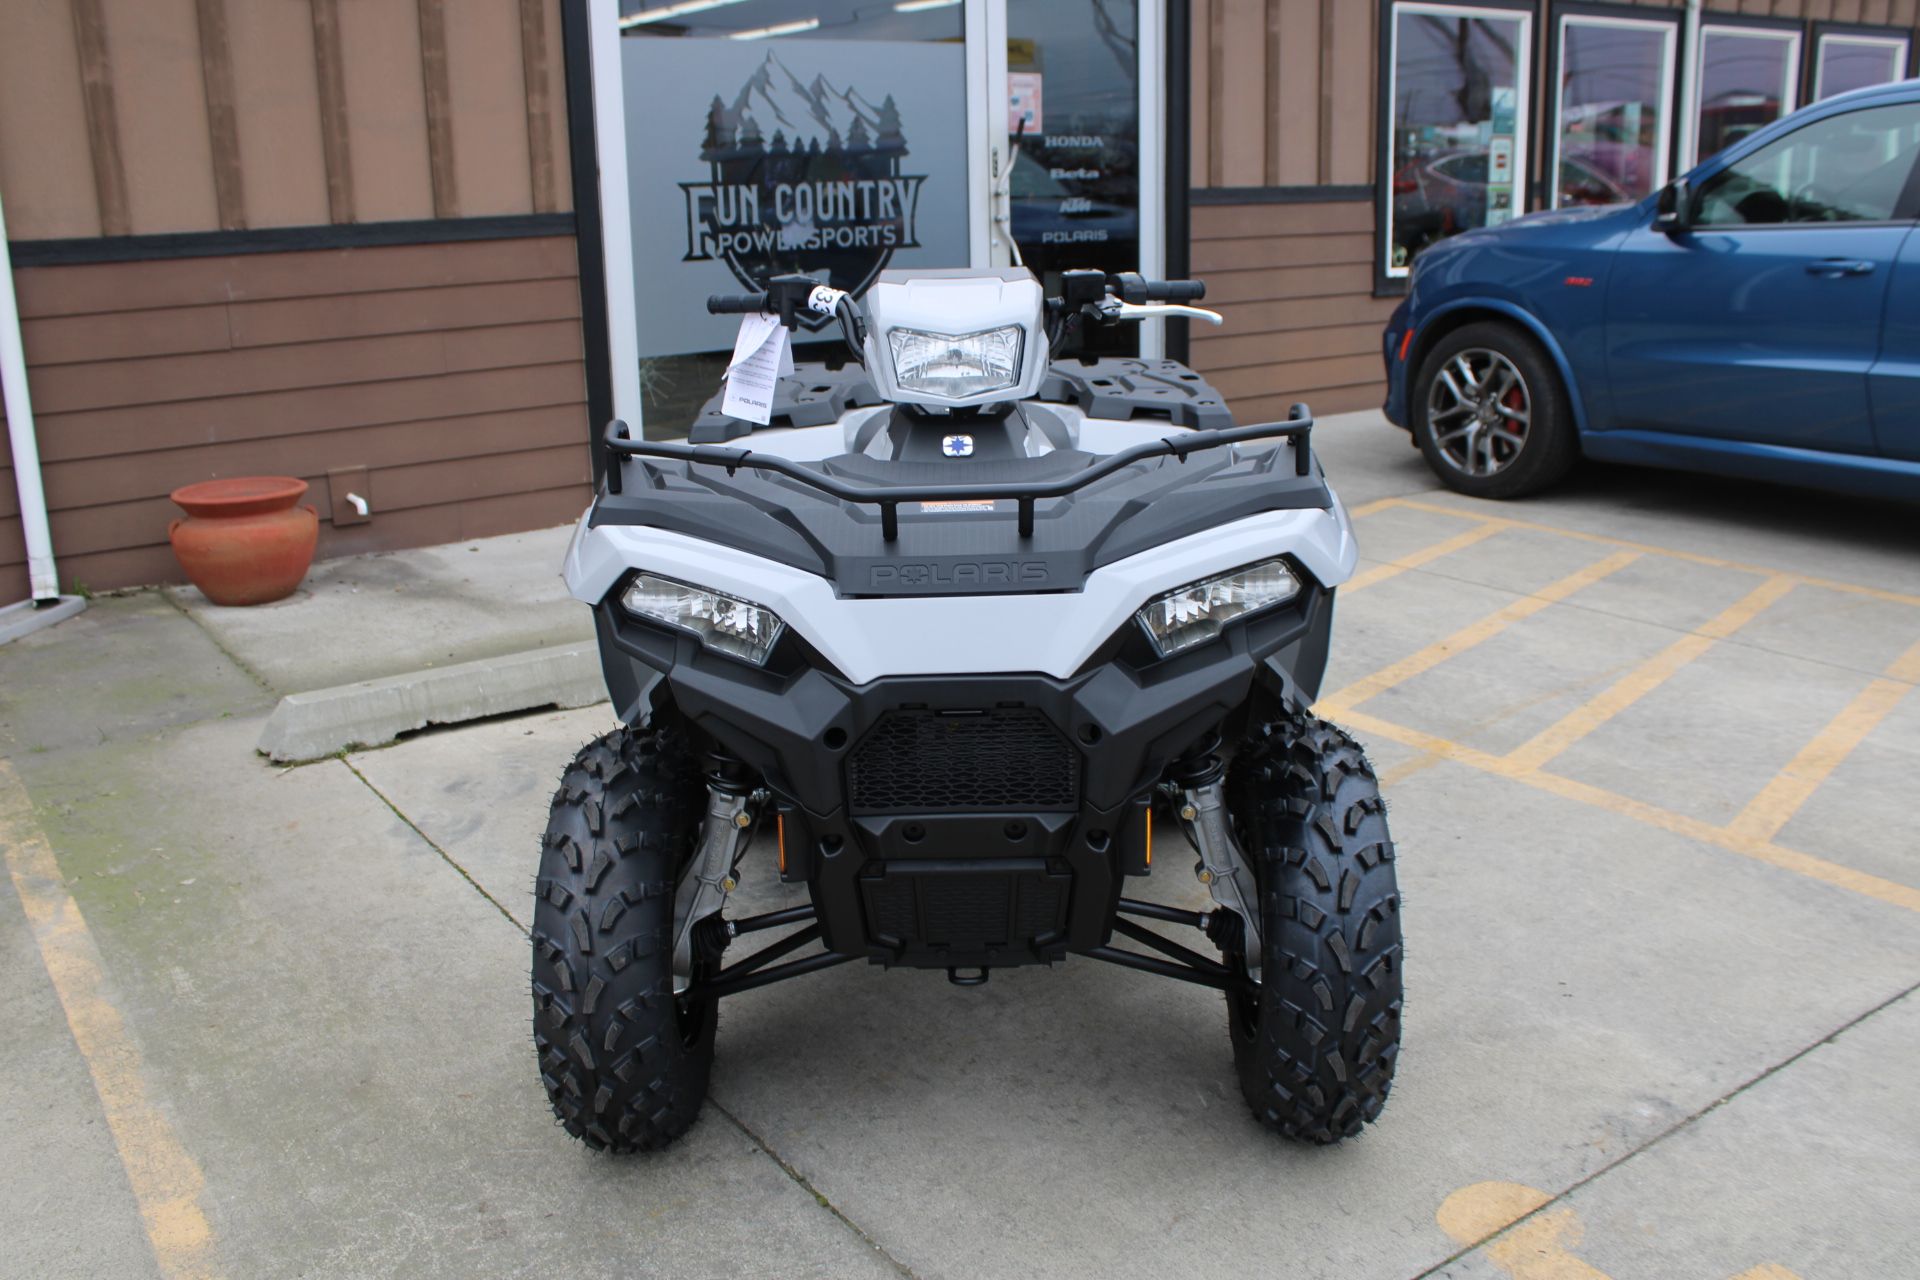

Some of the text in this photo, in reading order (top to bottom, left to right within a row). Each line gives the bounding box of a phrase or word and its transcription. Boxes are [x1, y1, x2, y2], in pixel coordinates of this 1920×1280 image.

[1044, 135, 1104, 148] HONDA
[1049, 167, 1100, 179] Beta
[687, 178, 921, 257] FUN COUNTRY
[717, 224, 897, 255] POWERSPORTS
[1042, 229, 1108, 243] POLARIS
[870, 560, 1050, 588] POLARIS
